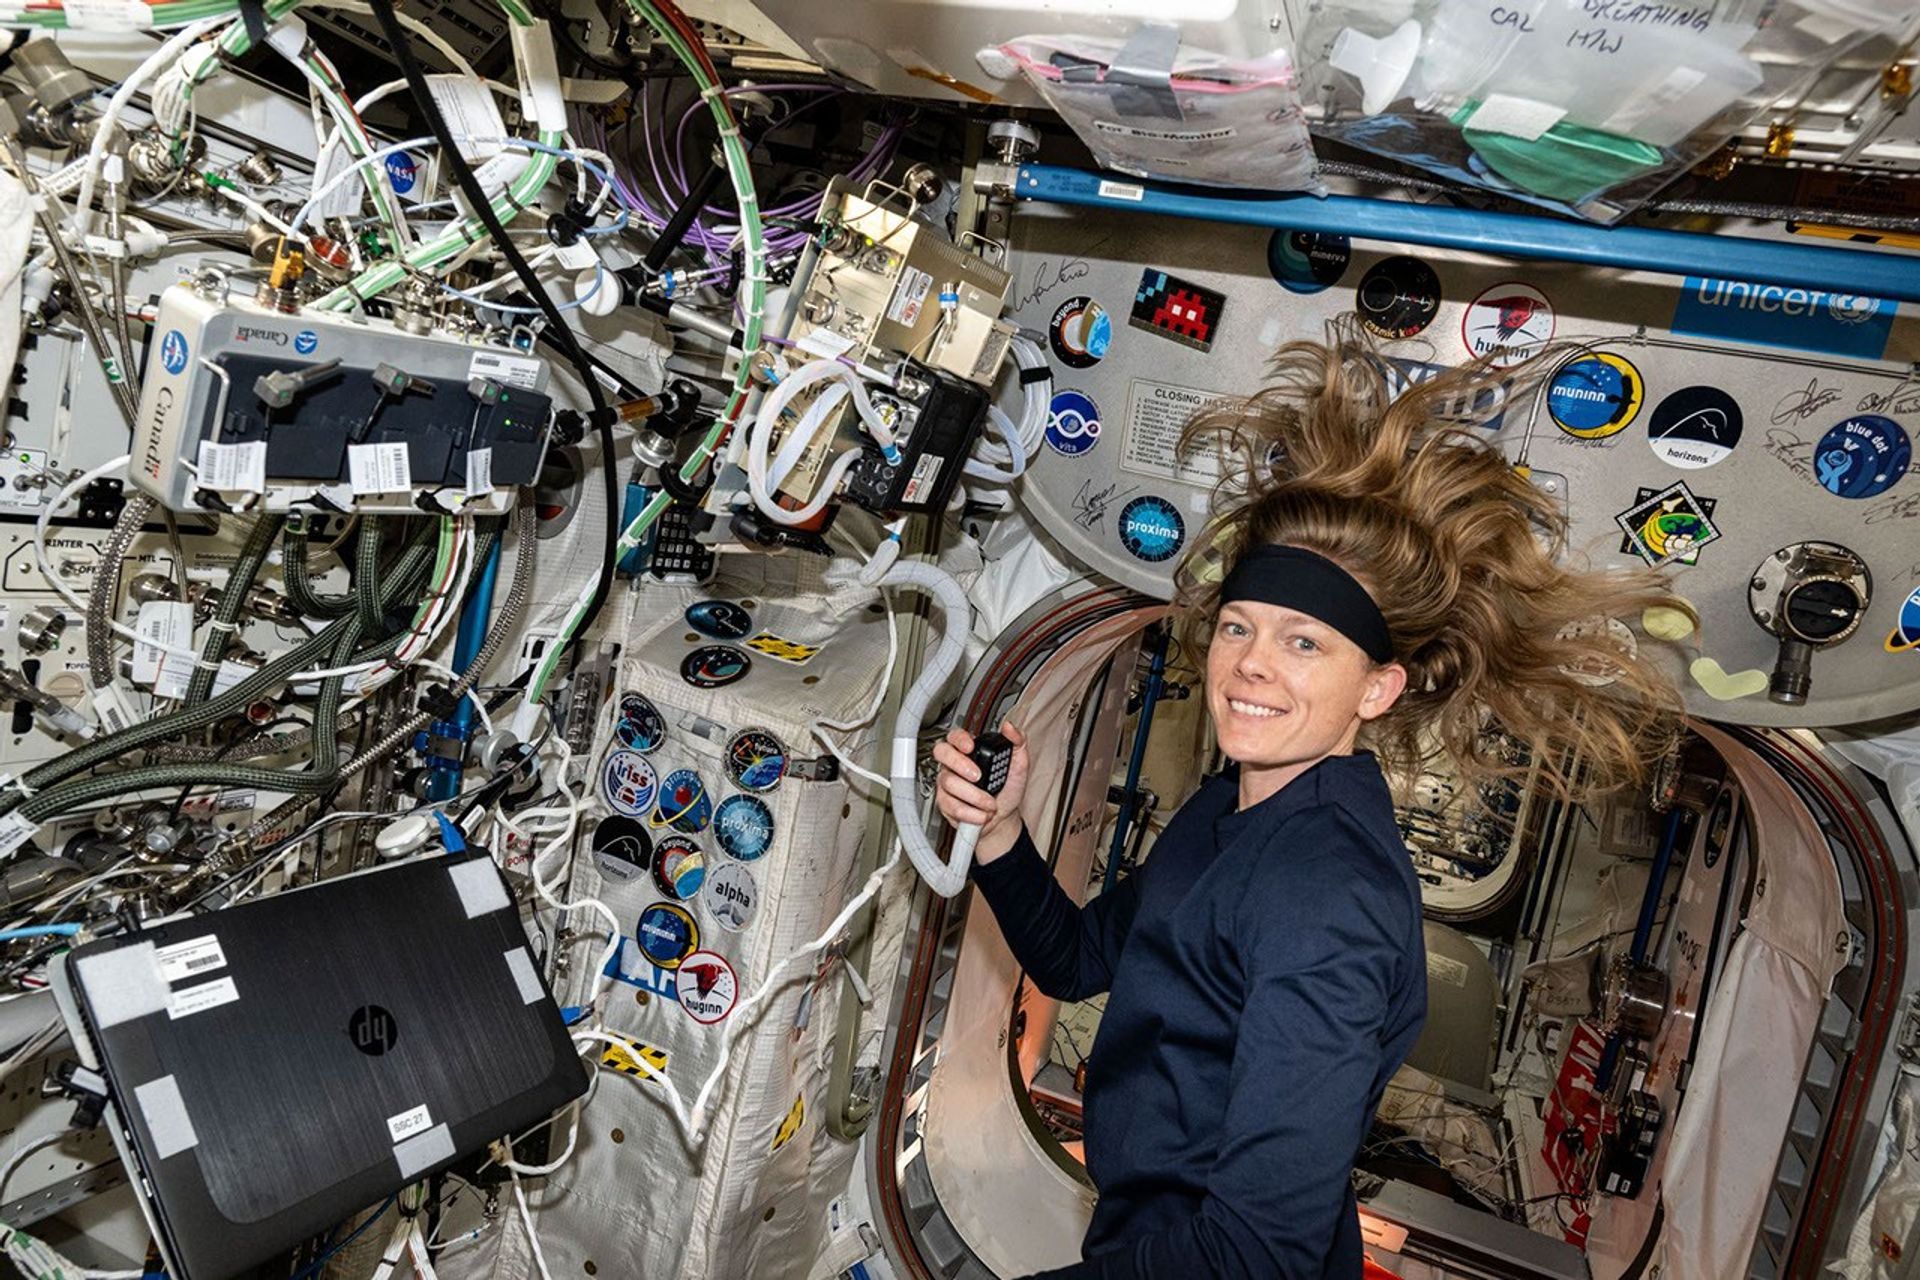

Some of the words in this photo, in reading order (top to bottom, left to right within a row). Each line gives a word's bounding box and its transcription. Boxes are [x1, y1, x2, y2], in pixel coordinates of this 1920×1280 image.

[1490, 7, 1534, 32] CAL
[1567, 29, 1623, 53] H/W
[1097, 122, 1122, 133] For
[1131, 128, 1233, 140] Bio-Monitor
[386, 162, 414, 182] NASA
[1310, 249, 1346, 263] minerva
[1051, 298, 1080, 327] beyond
[235, 325, 289, 347] Canada
[1364, 320, 1396, 338] cosmic
[1399, 325, 1420, 338] kiss
[1154, 388, 1201, 405] CLOSING
[1552, 384, 1607, 403] muninn
[144, 386, 175, 476] Canada
[1845, 421, 1872, 438] blue
[1871, 434, 1889, 454] dot
[1058, 441, 1077, 453] vita
[1667, 448, 1708, 464] horizons
[1127, 520, 1180, 540] proxima
[138, 554, 156, 563] MTL
[615, 760, 648, 788] iriss
[720, 816, 769, 840] proxima
[661, 838, 691, 850] beyond
[601, 861, 628, 880] horizons
[715, 881, 751, 909] alpha
[641, 922, 676, 942] muninn
[685, 996, 723, 1015] huginn
[393, 1118, 413, 1133] SSC
[413, 1112, 424, 1125] 27
